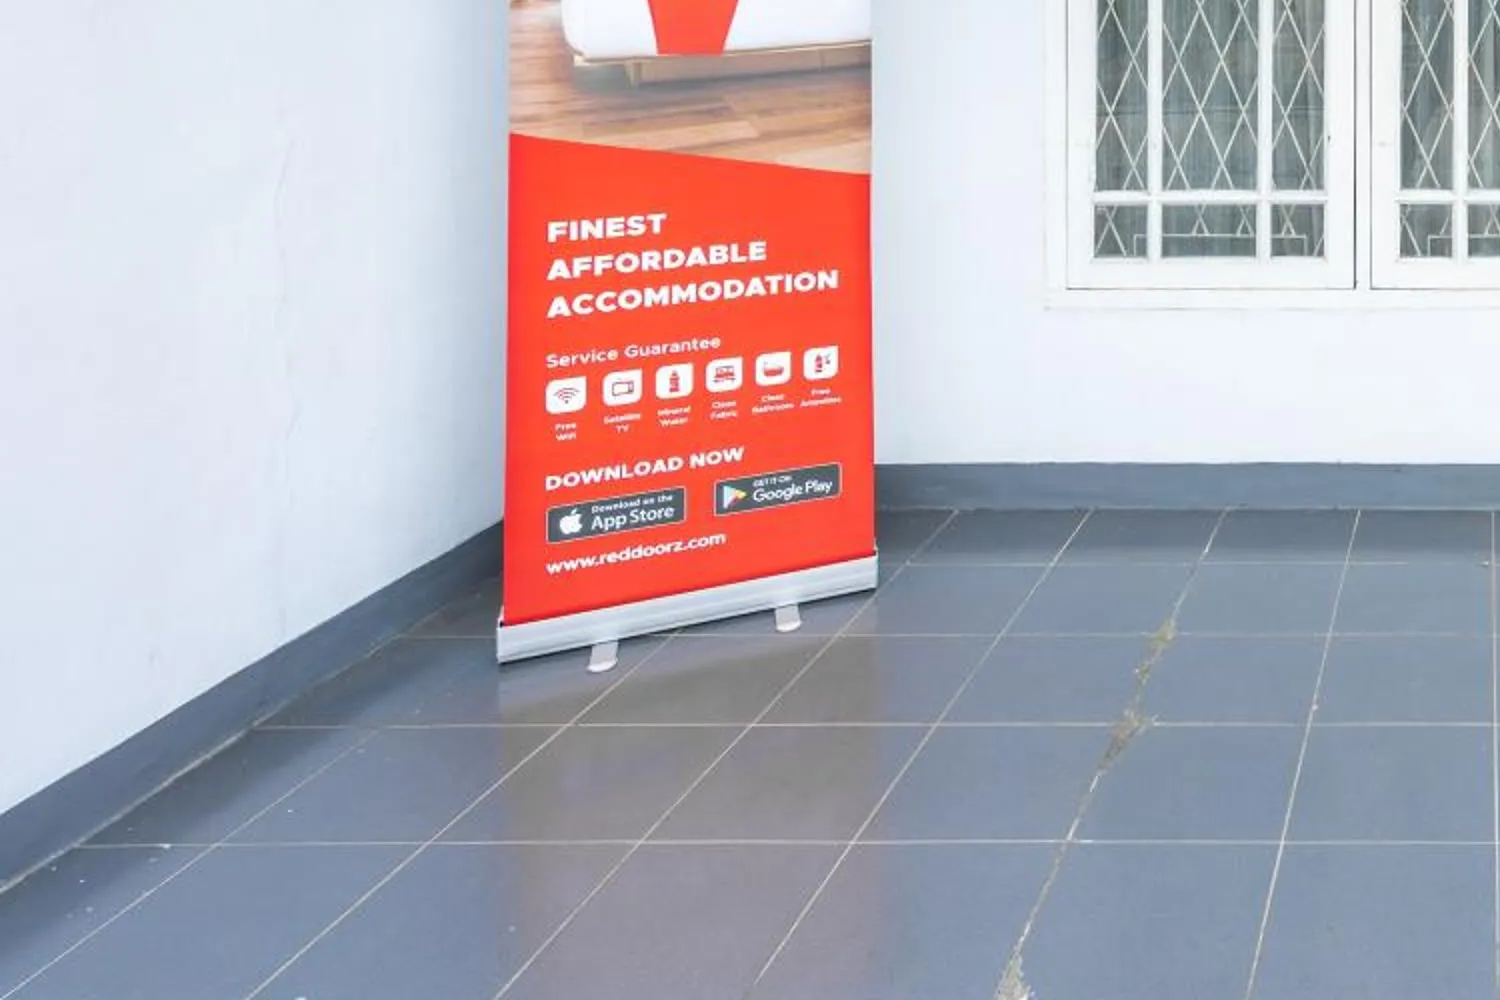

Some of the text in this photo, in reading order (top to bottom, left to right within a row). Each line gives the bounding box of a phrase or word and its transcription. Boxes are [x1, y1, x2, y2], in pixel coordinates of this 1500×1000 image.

[547, 213, 667, 243] FINEST
[546, 241, 767, 280] AFFORDABLE
[546, 270, 839, 318] ACCOMMODATION
[546, 336, 721, 369] Service Guarantee
[545, 447, 745, 491] DOWNLOAD NOW
[591, 499, 641, 514] Download
[752, 479, 833, 503] Google Play
[591, 506, 675, 531] App Store
[546, 533, 727, 575] www.reddoorz.com
